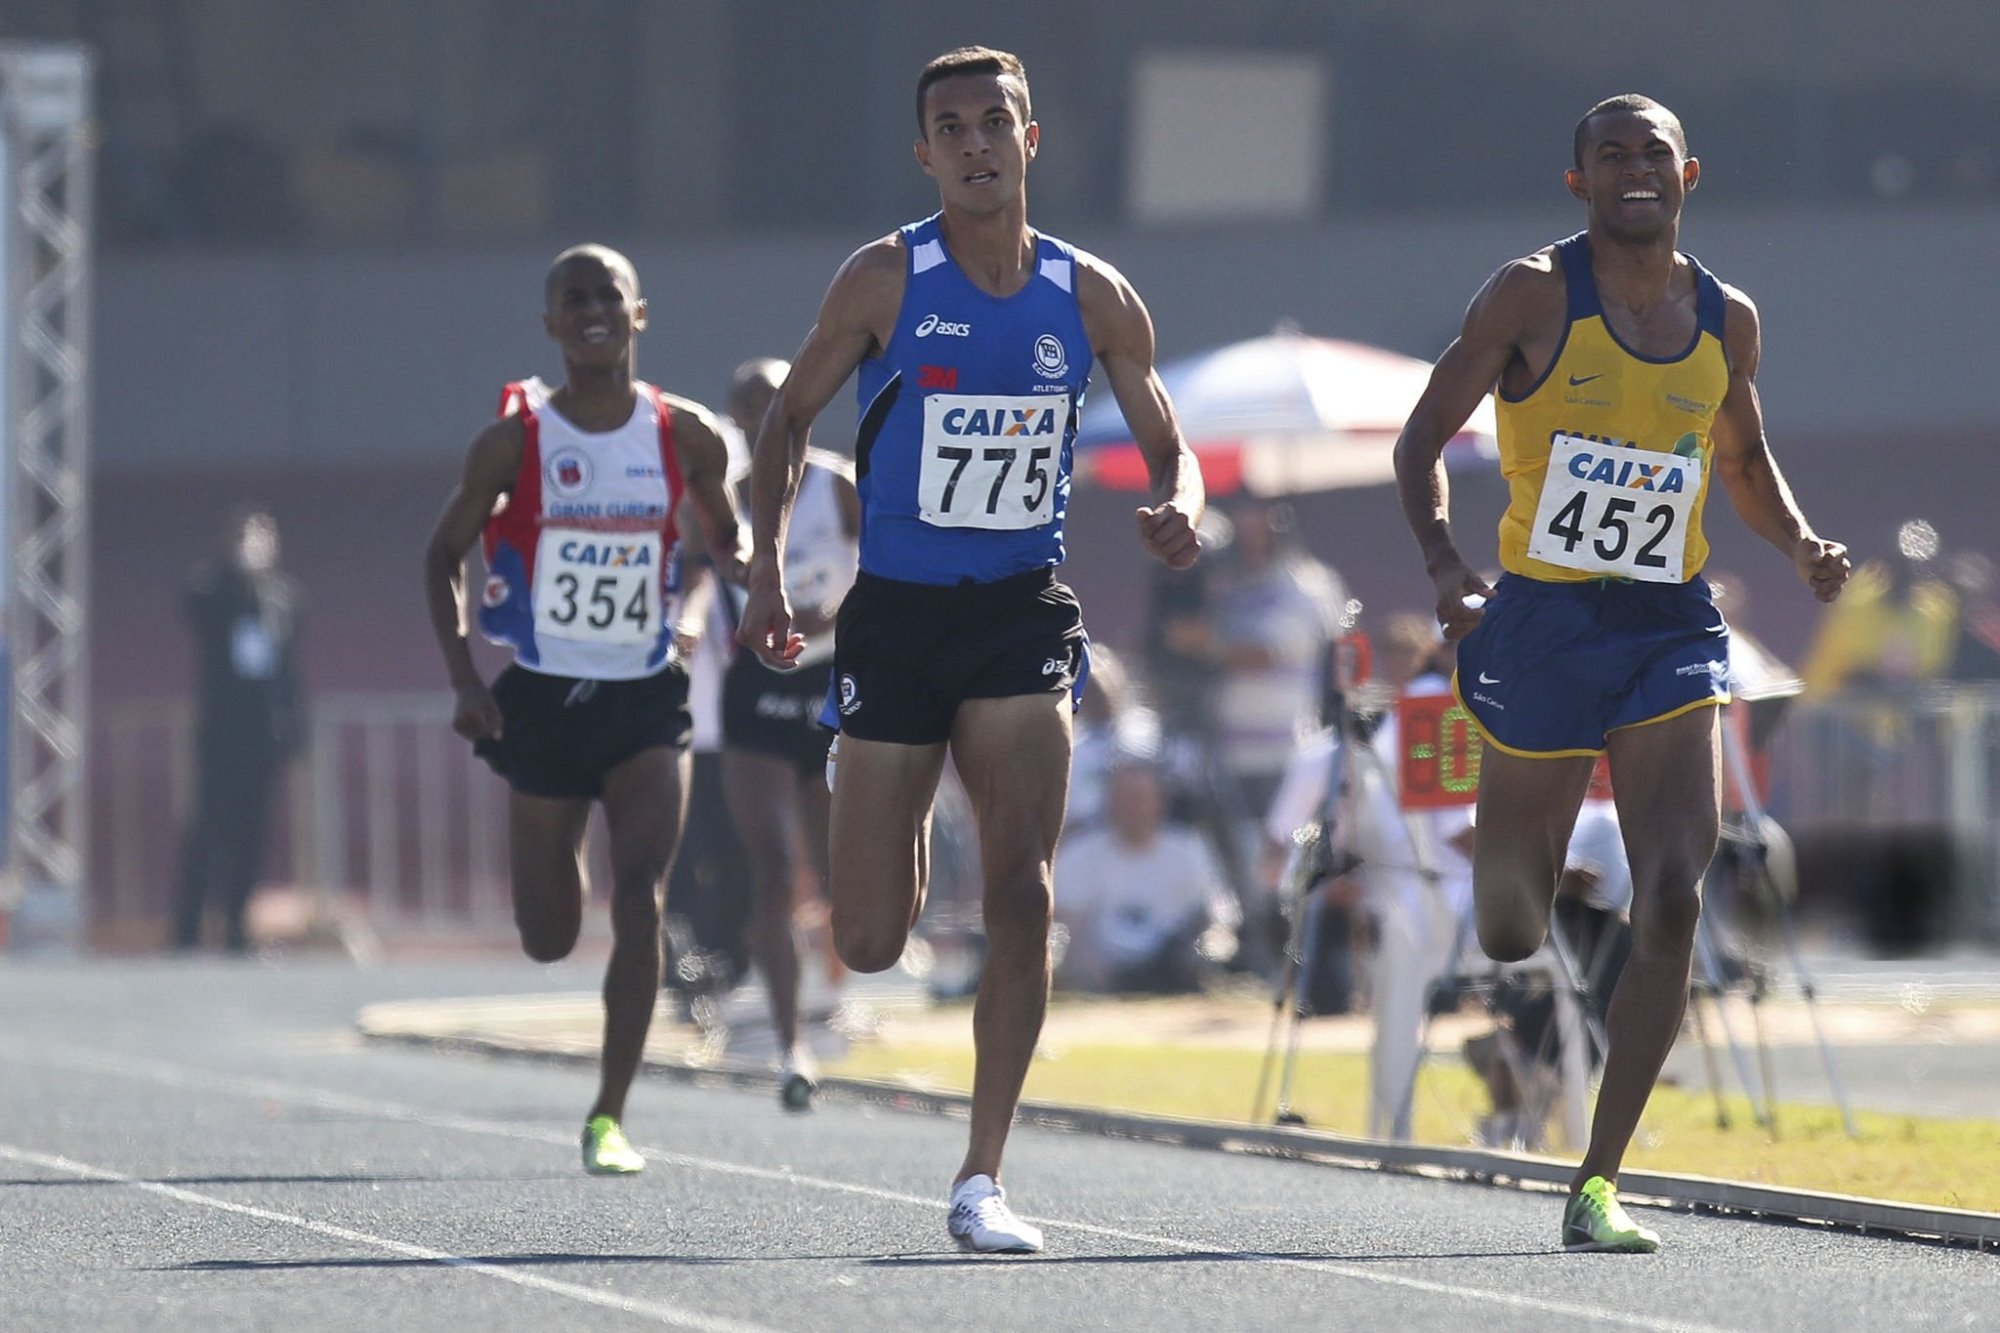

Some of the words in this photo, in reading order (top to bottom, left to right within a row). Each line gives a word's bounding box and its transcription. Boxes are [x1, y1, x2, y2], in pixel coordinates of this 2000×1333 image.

[935, 321, 971, 337] asics
[917, 363, 958, 392] 3M
[942, 407, 1055, 437] CAIXA
[936, 445, 1052, 515] 775
[1568, 452, 1684, 494] CAIXA
[1547, 490, 1676, 568] 452
[559, 541, 651, 568] CAIXA
[548, 571, 649, 633] 354
